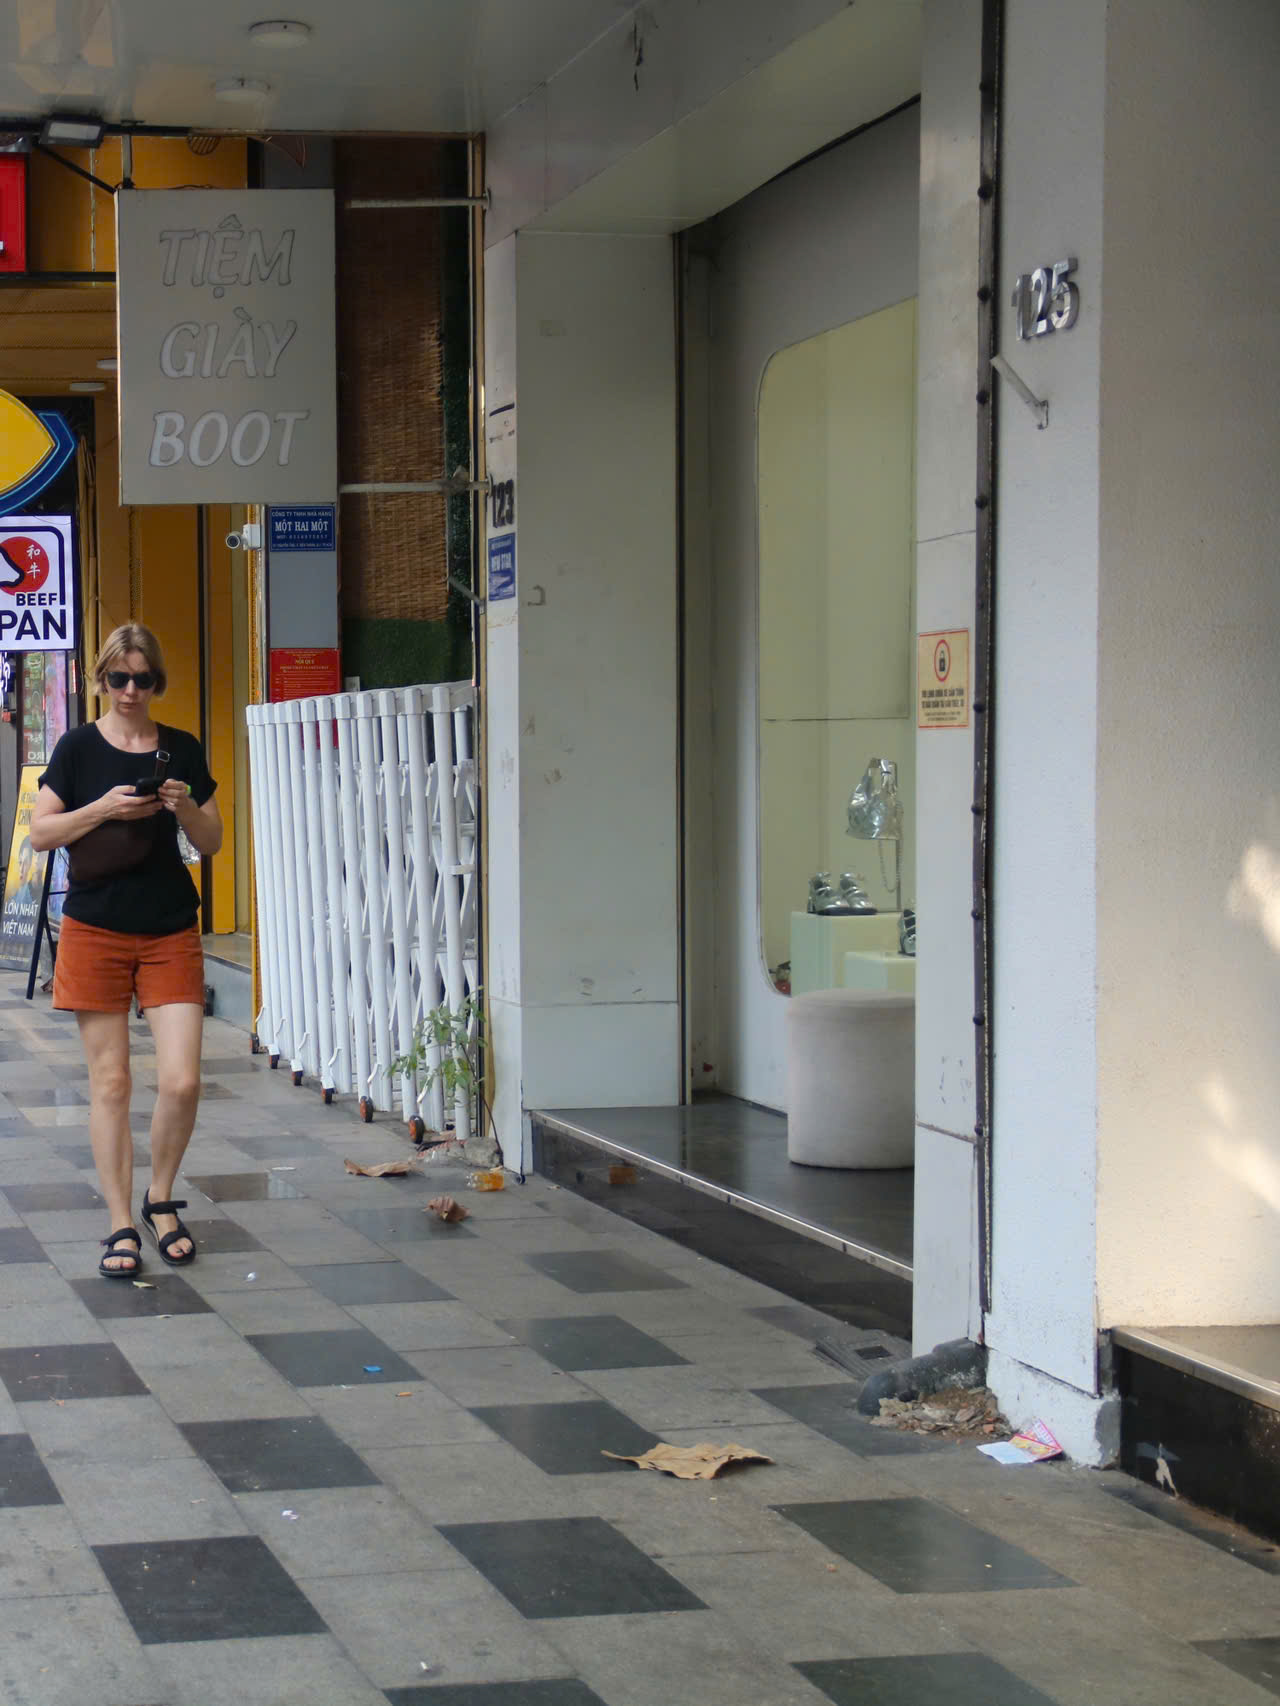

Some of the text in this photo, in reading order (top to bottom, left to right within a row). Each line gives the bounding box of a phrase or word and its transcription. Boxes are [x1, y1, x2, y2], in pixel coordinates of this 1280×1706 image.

[159, 214, 296, 299] TIỆM
[1013, 258, 1078, 340] 125
[160, 306, 297, 379] GIÀY
[149, 409, 310, 467] BOOT
[275, 518, 328, 534] MỘT HAI MỘT
[26, 544, 41, 579] 和牛
[16, 593, 57, 606] BEEF
[2, 918, 34, 937] VIỆT NAM
